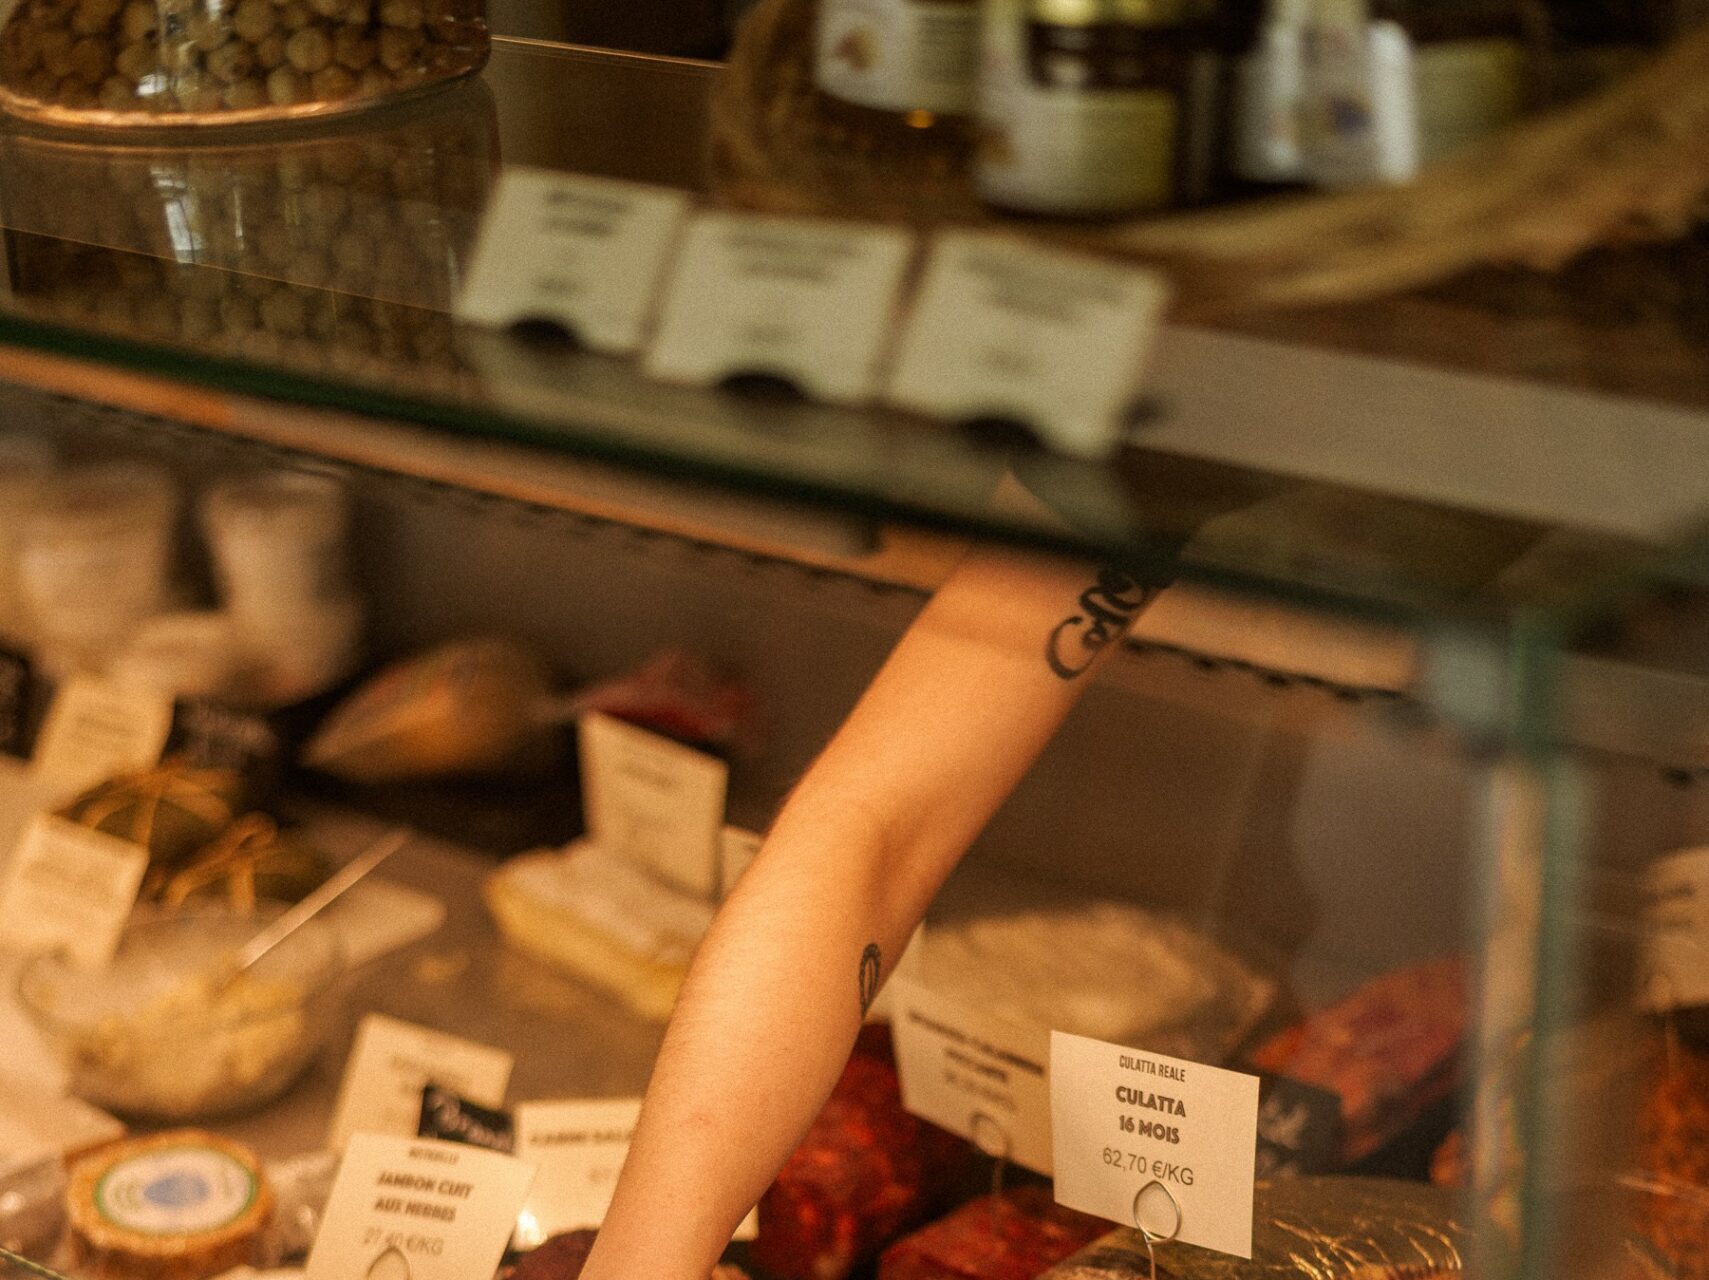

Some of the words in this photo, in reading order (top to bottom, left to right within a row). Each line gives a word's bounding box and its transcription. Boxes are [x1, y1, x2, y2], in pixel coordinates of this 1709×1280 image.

[1119, 1055, 1156, 1075] CULATTA
[1158, 1064, 1186, 1082] REALE
[1115, 1085, 1187, 1117] CULATTA
[1119, 1115, 1135, 1131] 16
[1138, 1119, 1180, 1145] MOIS
[1102, 1147, 1147, 1174] 62,70
[1151, 1161, 1194, 1186] €/KG
[438, 1182, 474, 1199] CUIT
